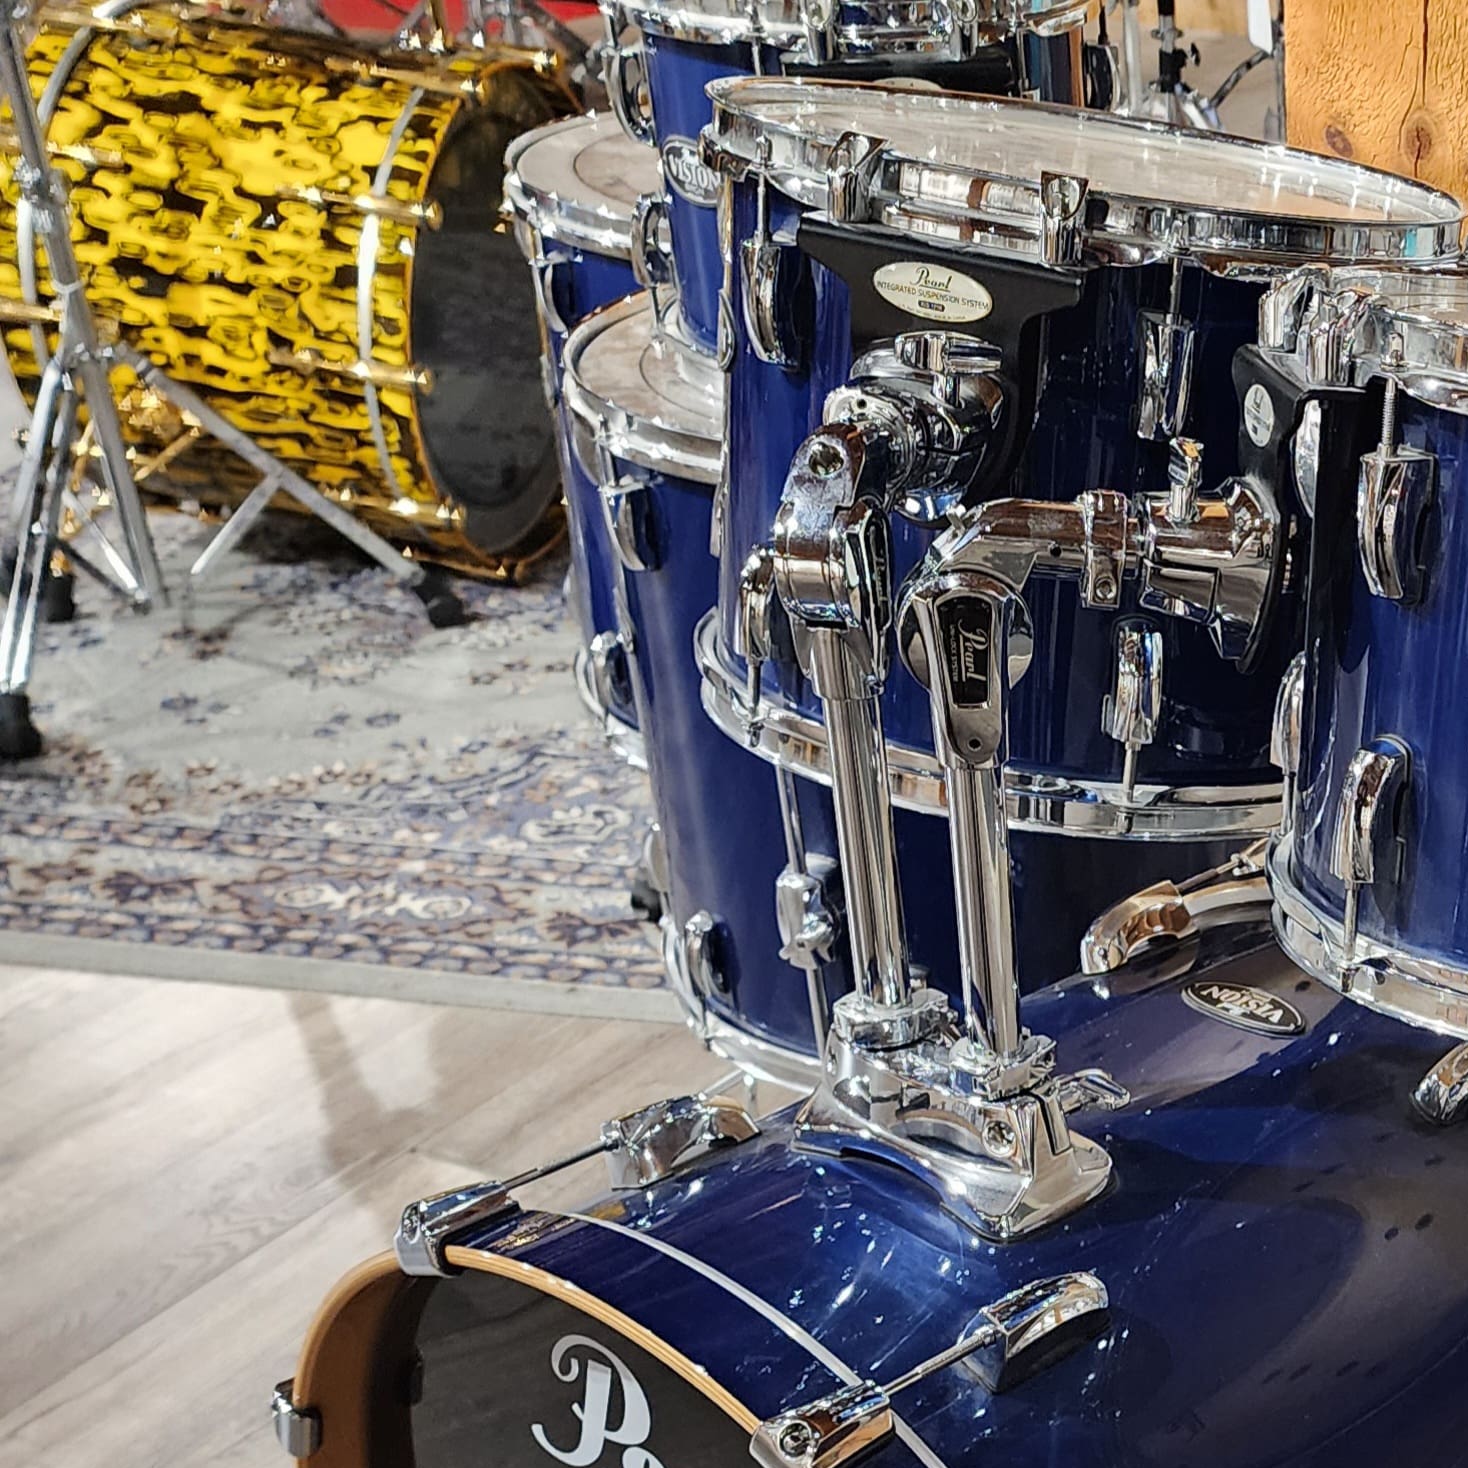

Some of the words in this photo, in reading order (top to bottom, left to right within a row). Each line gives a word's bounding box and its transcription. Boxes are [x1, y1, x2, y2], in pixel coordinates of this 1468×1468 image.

[877, 281, 917, 296] INTEGRATED
[910, 266, 952, 292] Pearl
[957, 618, 989, 682] Pearl
[1200, 986, 1284, 1023] VISION
